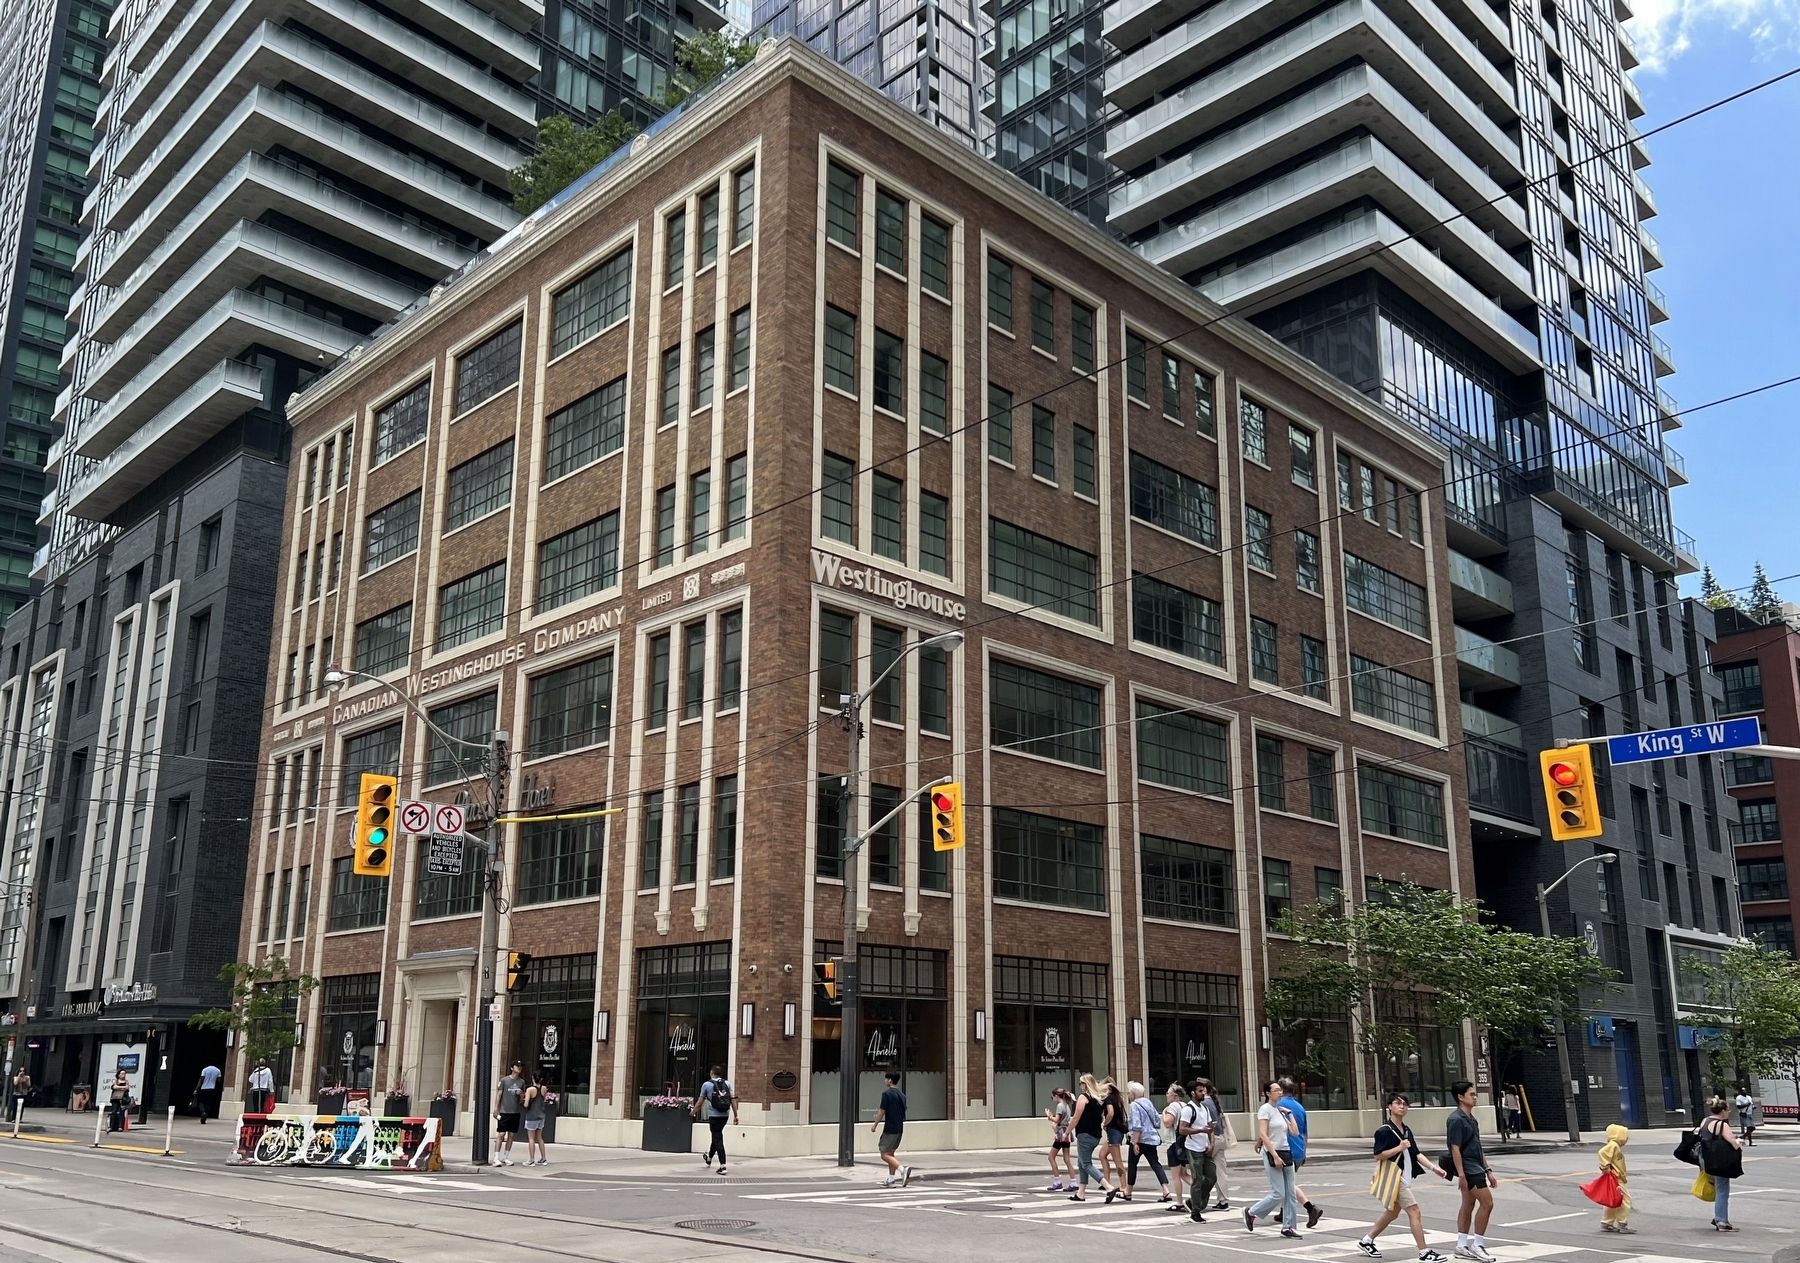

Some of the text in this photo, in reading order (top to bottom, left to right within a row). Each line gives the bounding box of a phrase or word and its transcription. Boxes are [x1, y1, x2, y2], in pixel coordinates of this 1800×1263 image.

[810, 548, 966, 621] Westinghouse
[332, 590, 672, 725] CANADIAN WESTINGHOUSE COMPANY LIMITED
[1638, 724, 1725, 754] King St W
[436, 839, 459, 847] VEHICLES
[442, 845, 462, 853] BICYCLES
